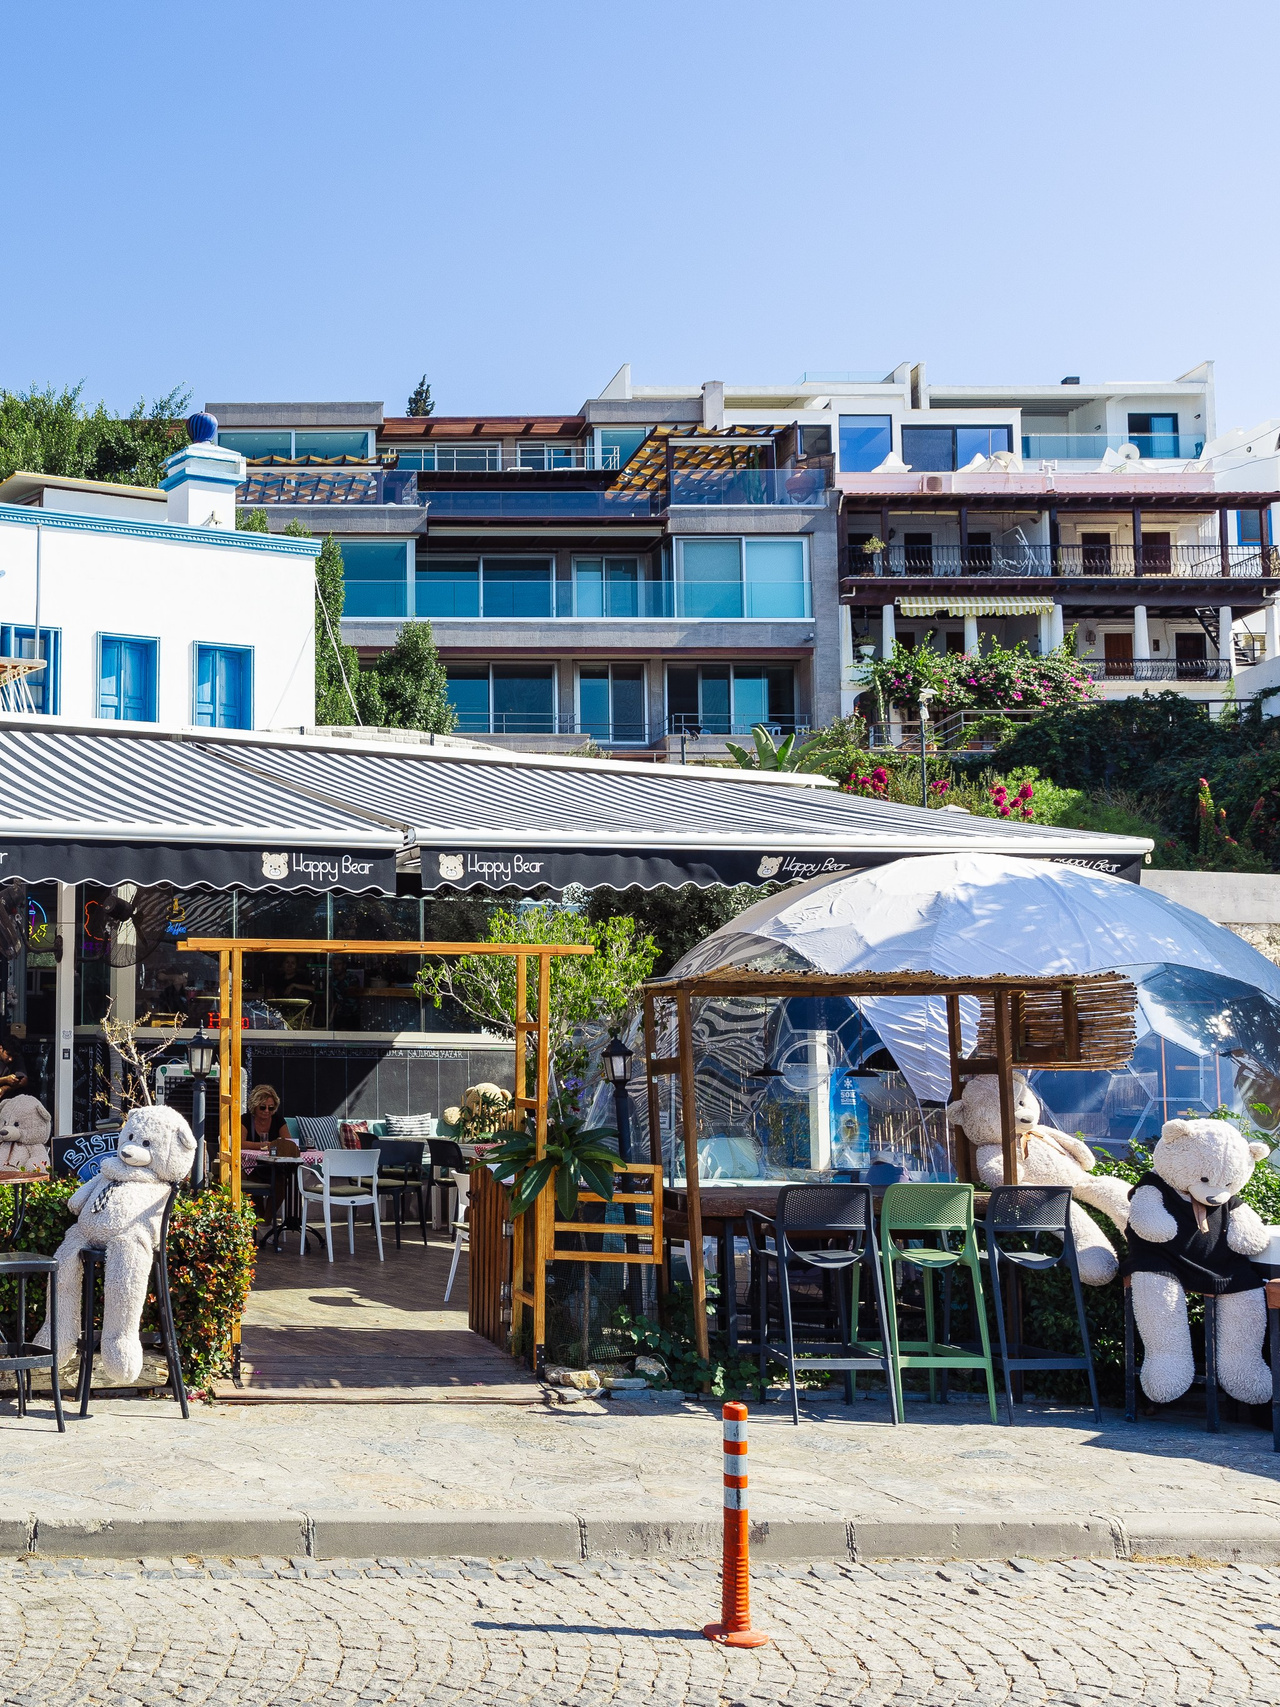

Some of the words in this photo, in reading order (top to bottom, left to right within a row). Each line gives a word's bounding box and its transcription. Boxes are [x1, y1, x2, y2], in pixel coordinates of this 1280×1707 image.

[292, 852, 339, 882] Happy
[342, 854, 374, 875] Bear
[467, 853, 512, 882] Happy
[513, 854, 545, 873] Bear
[781, 856, 822, 877] Happy
[821, 857, 851, 871] Bear
[1093, 859, 1121, 873] Bear
